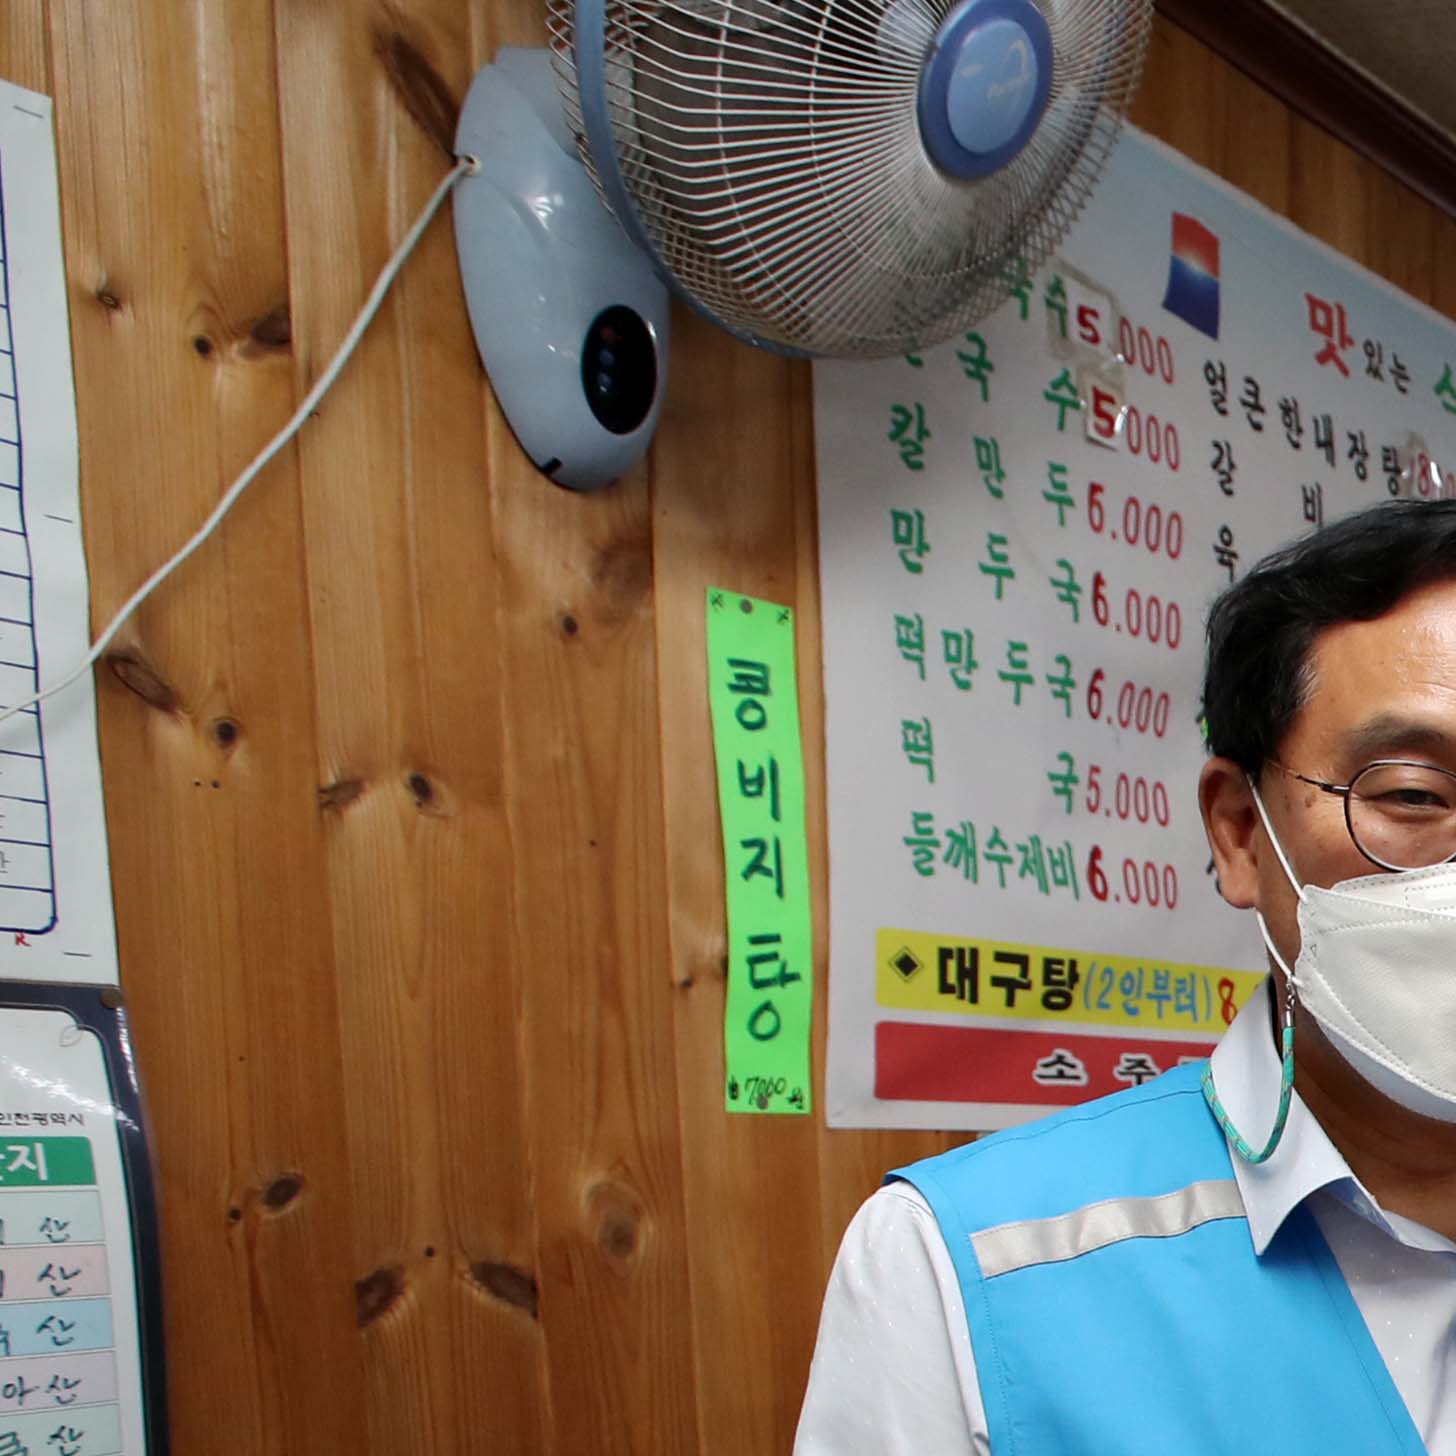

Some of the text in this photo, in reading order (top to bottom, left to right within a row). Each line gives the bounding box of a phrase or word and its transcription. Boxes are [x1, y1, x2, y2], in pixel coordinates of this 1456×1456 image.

[1092, 572, 1181, 650] 6.000
[1087, 668, 1169, 738] 6.000
[1086, 764, 1169, 828] 5.000
[1087, 845, 1178, 910] 6.000
